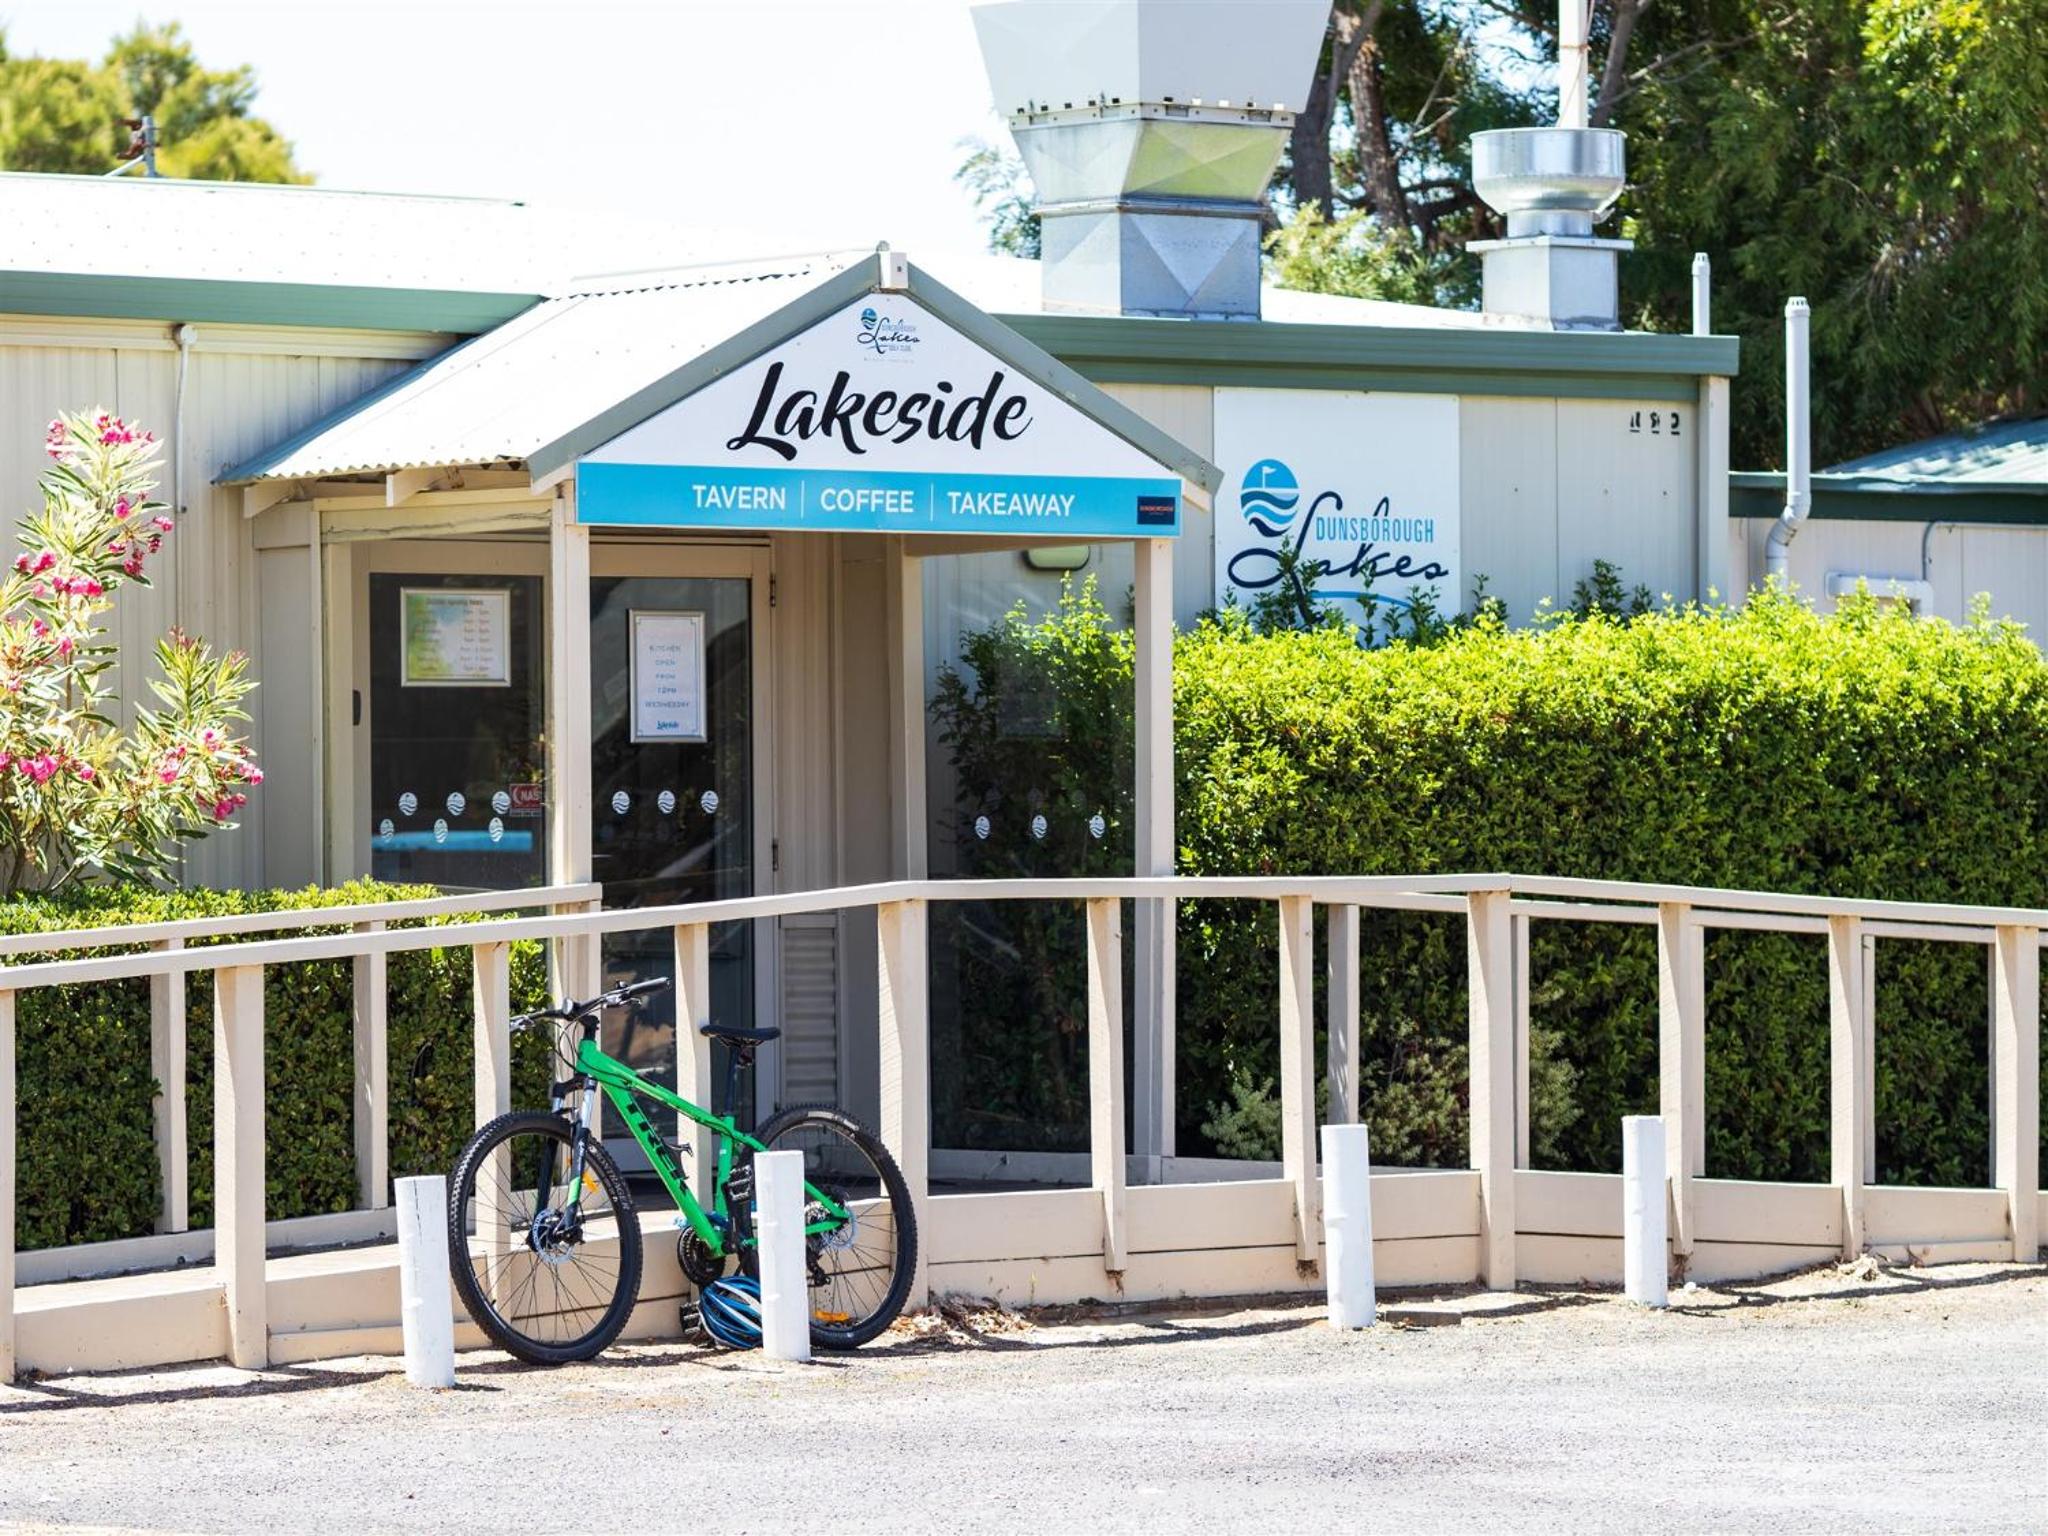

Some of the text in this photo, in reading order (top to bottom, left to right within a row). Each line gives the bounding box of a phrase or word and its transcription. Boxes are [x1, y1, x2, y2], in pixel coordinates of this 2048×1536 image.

[726, 361, 1034, 461] Lakeside
[692, 485, 1076, 517] TAVERN COFFEE TAKEAWAY
[1316, 516, 1434, 543] DUNSBOROUGH
[1227, 491, 1449, 622] Lakes
